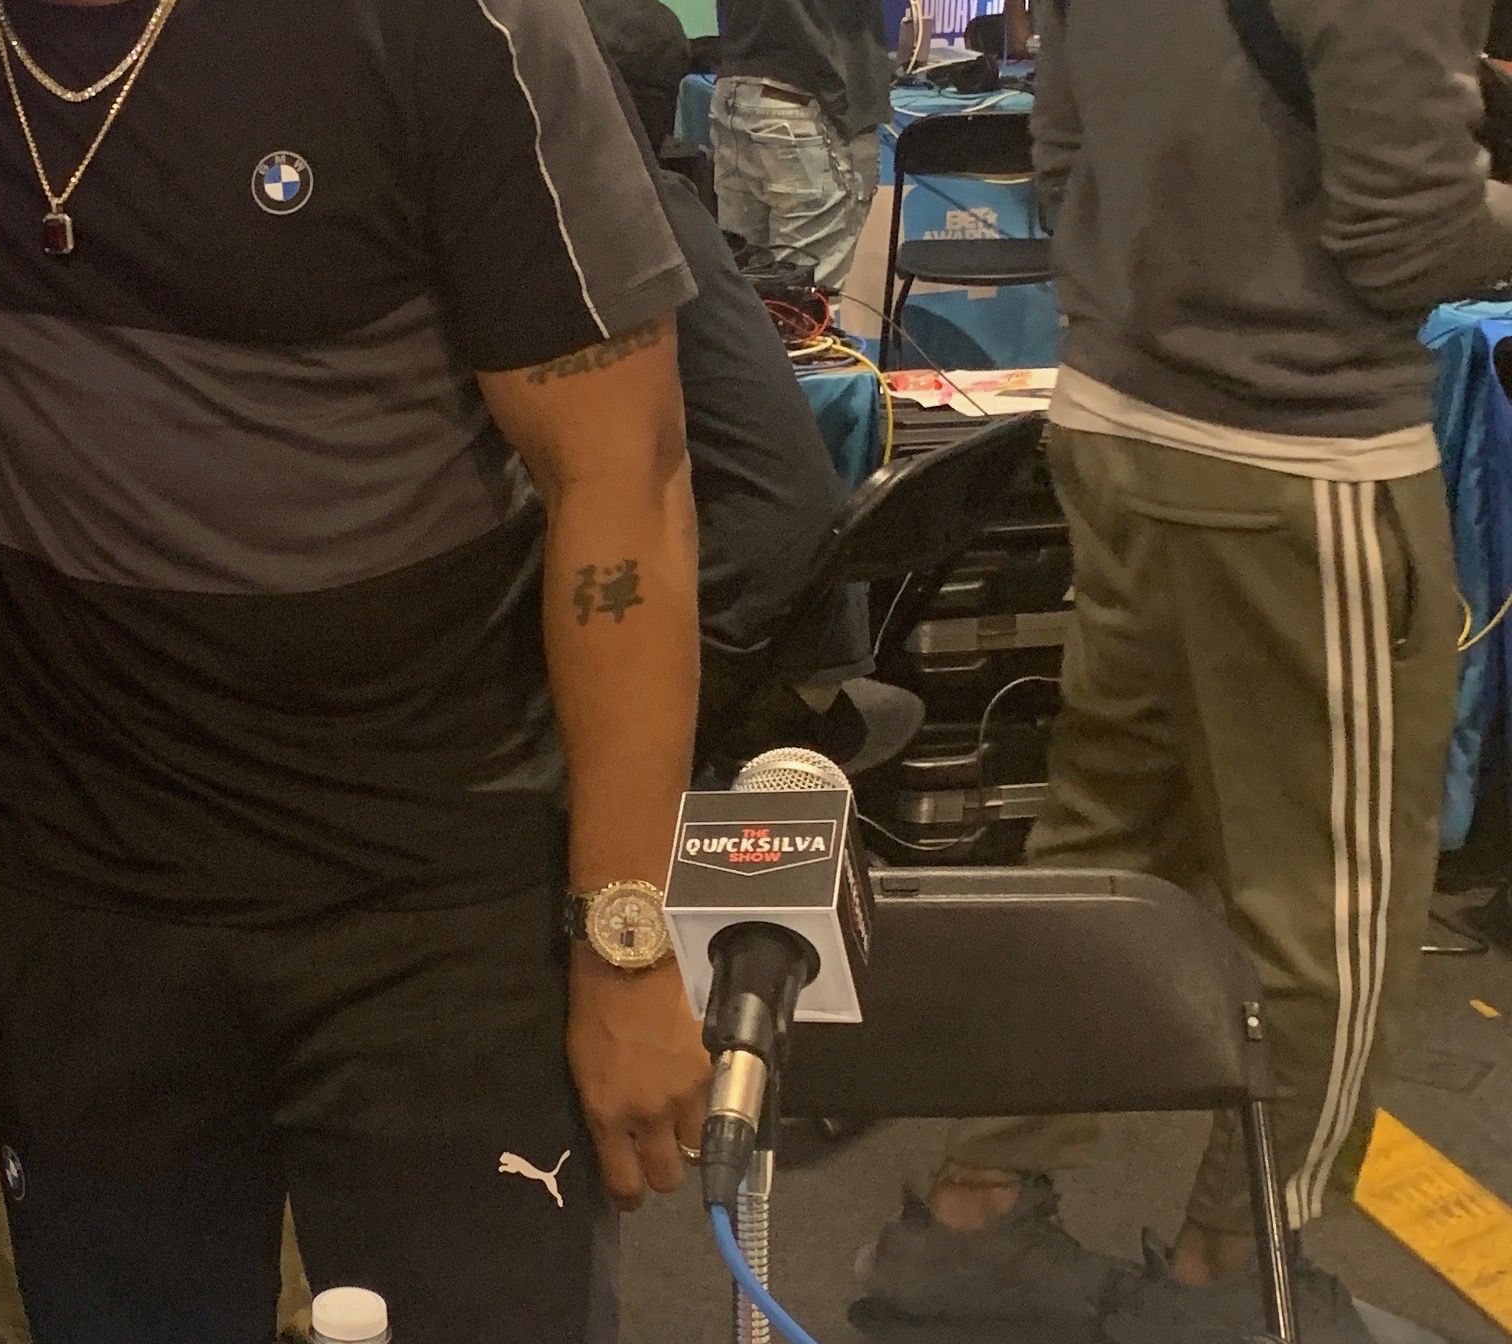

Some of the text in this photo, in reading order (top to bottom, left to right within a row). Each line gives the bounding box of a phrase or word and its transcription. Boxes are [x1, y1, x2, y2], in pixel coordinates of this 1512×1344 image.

[741, 828, 770, 839] THE
[685, 836, 826, 856] QUICKSILVA
[729, 852, 782, 863] SHOW
